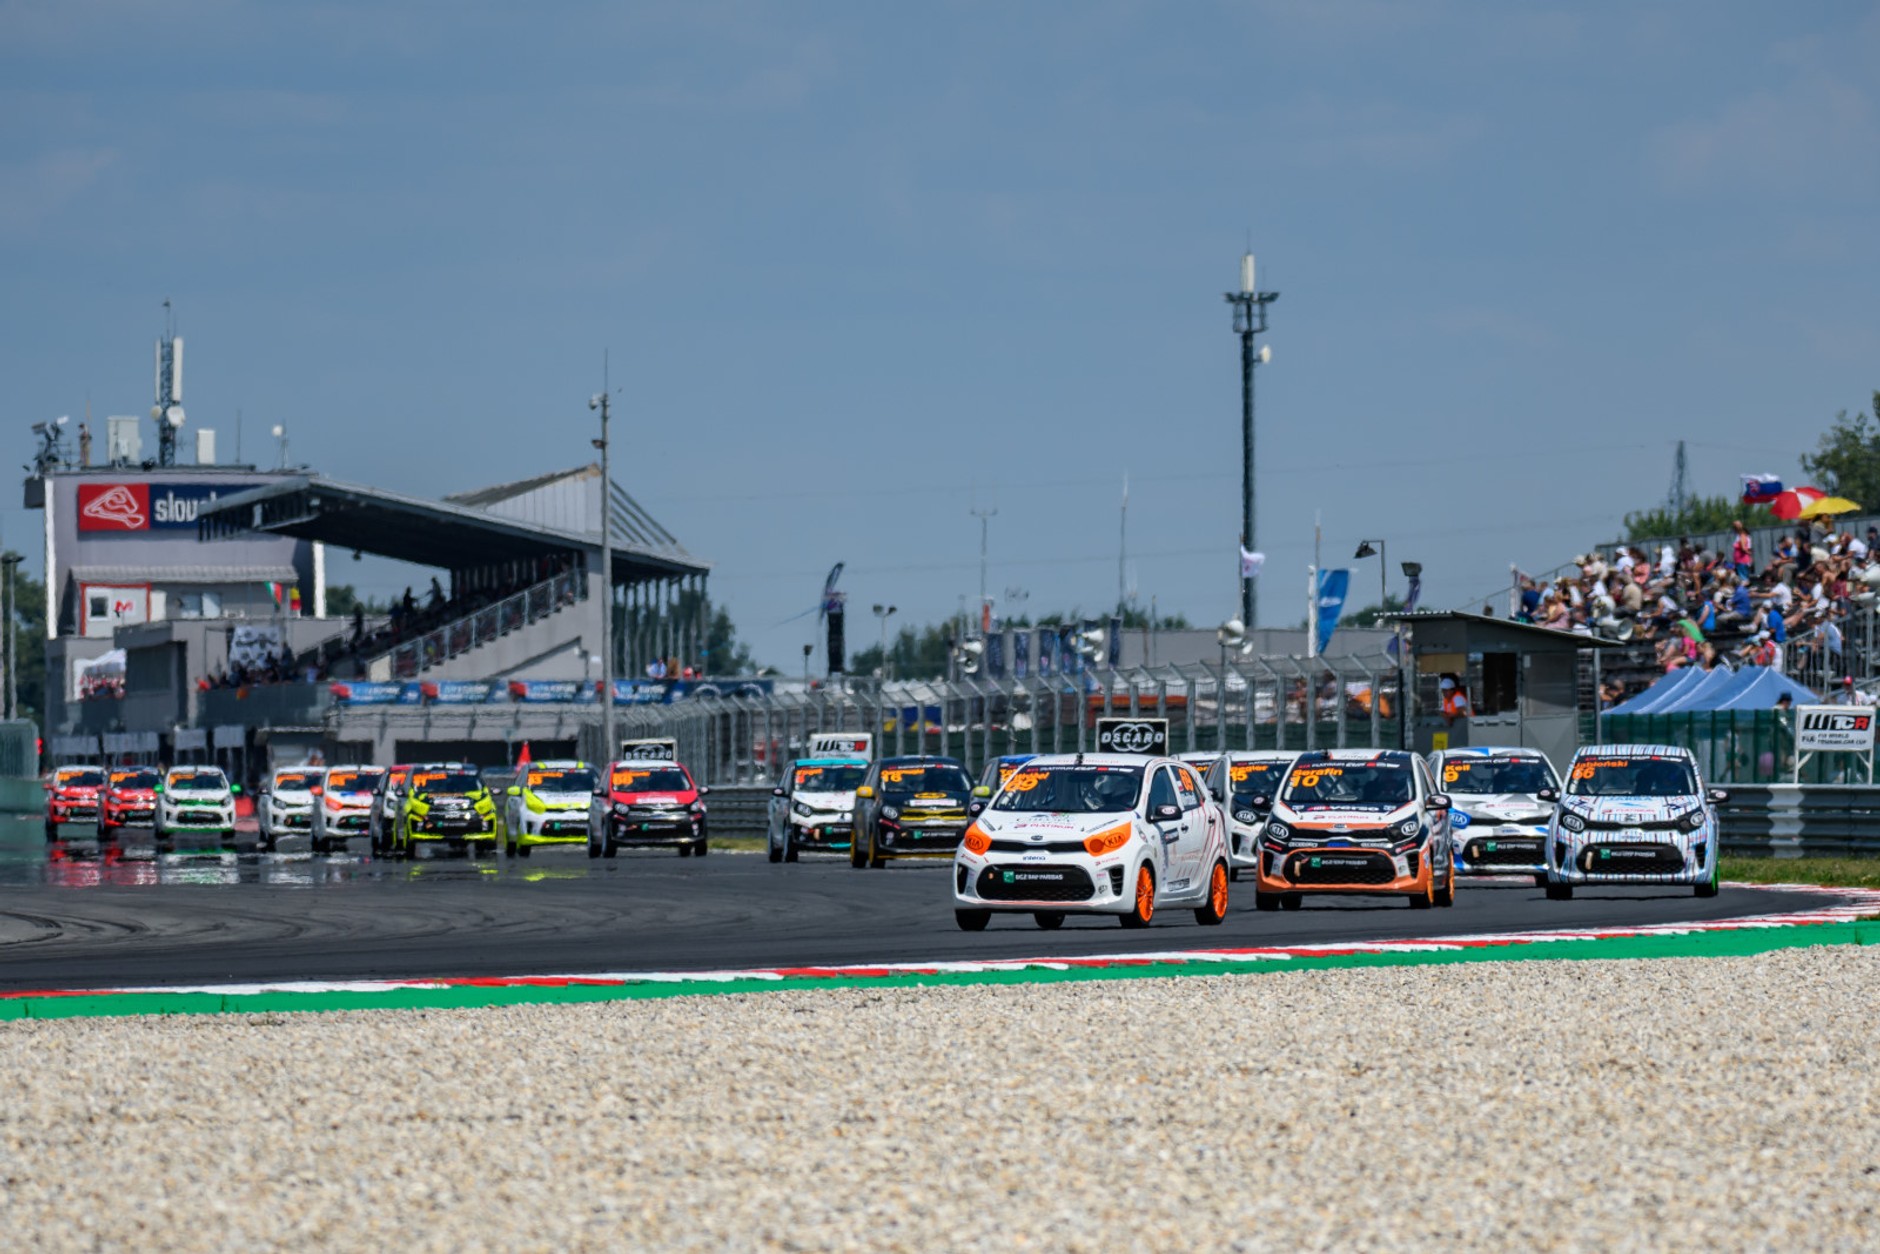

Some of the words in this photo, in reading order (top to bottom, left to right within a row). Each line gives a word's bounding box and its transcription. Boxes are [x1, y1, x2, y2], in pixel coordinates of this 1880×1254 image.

[1101, 731, 1165, 743] OSCARO
[1230, 770, 1248, 781] 15
[1292, 768, 1343, 776] Serafin
[1572, 768, 1595, 779] 66
[1290, 776, 1320, 787] 10
[1565, 818, 1581, 828] KIA
[1270, 825, 1286, 837] KIA
[967, 837, 981, 848] KIA
[1107, 835, 1123, 845] KIA
